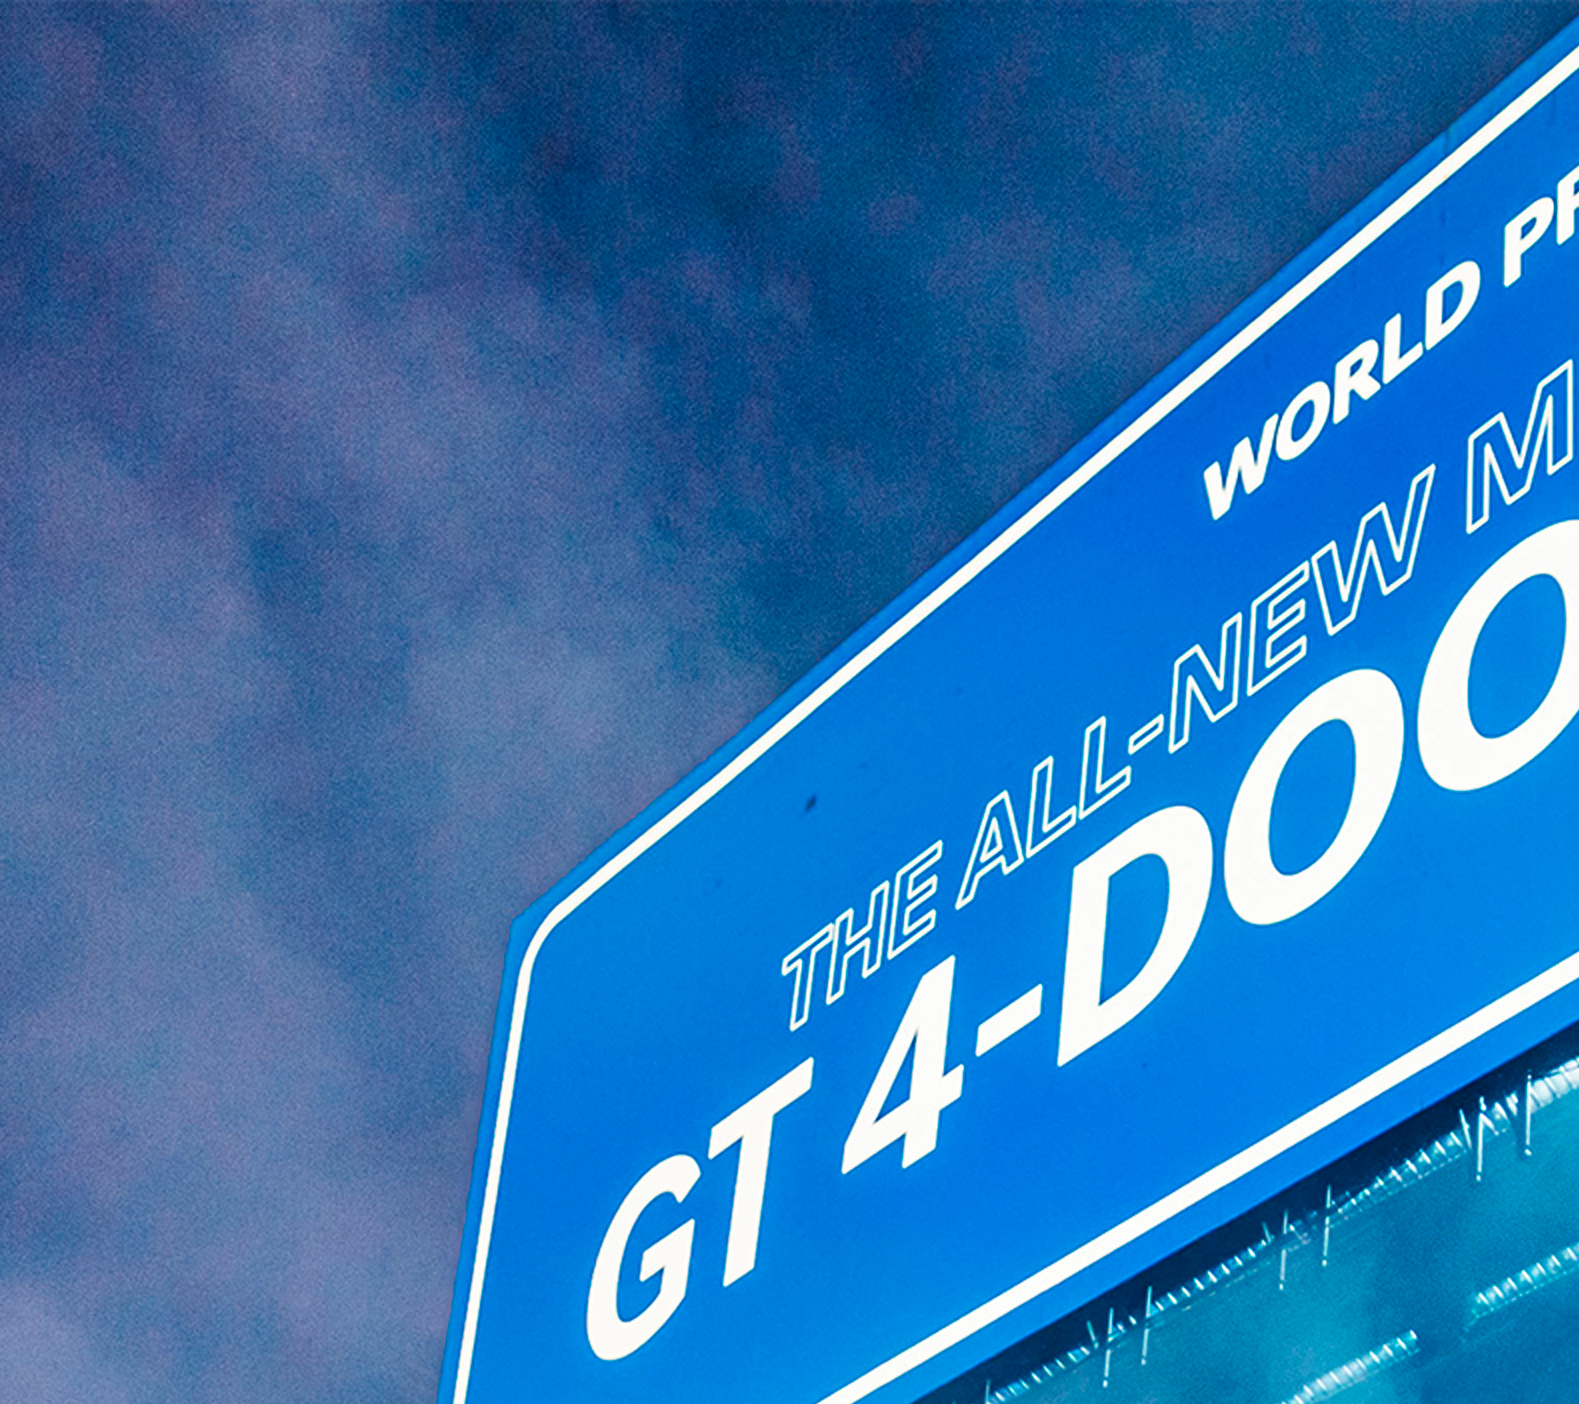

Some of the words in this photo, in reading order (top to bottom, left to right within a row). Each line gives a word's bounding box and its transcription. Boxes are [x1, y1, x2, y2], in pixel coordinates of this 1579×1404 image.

[1203, 260, 1481, 520] WORLD
[781, 839, 943, 1032] THE
[955, 463, 1436, 910] ALL-NEW
[586, 1057, 814, 1361] GT
